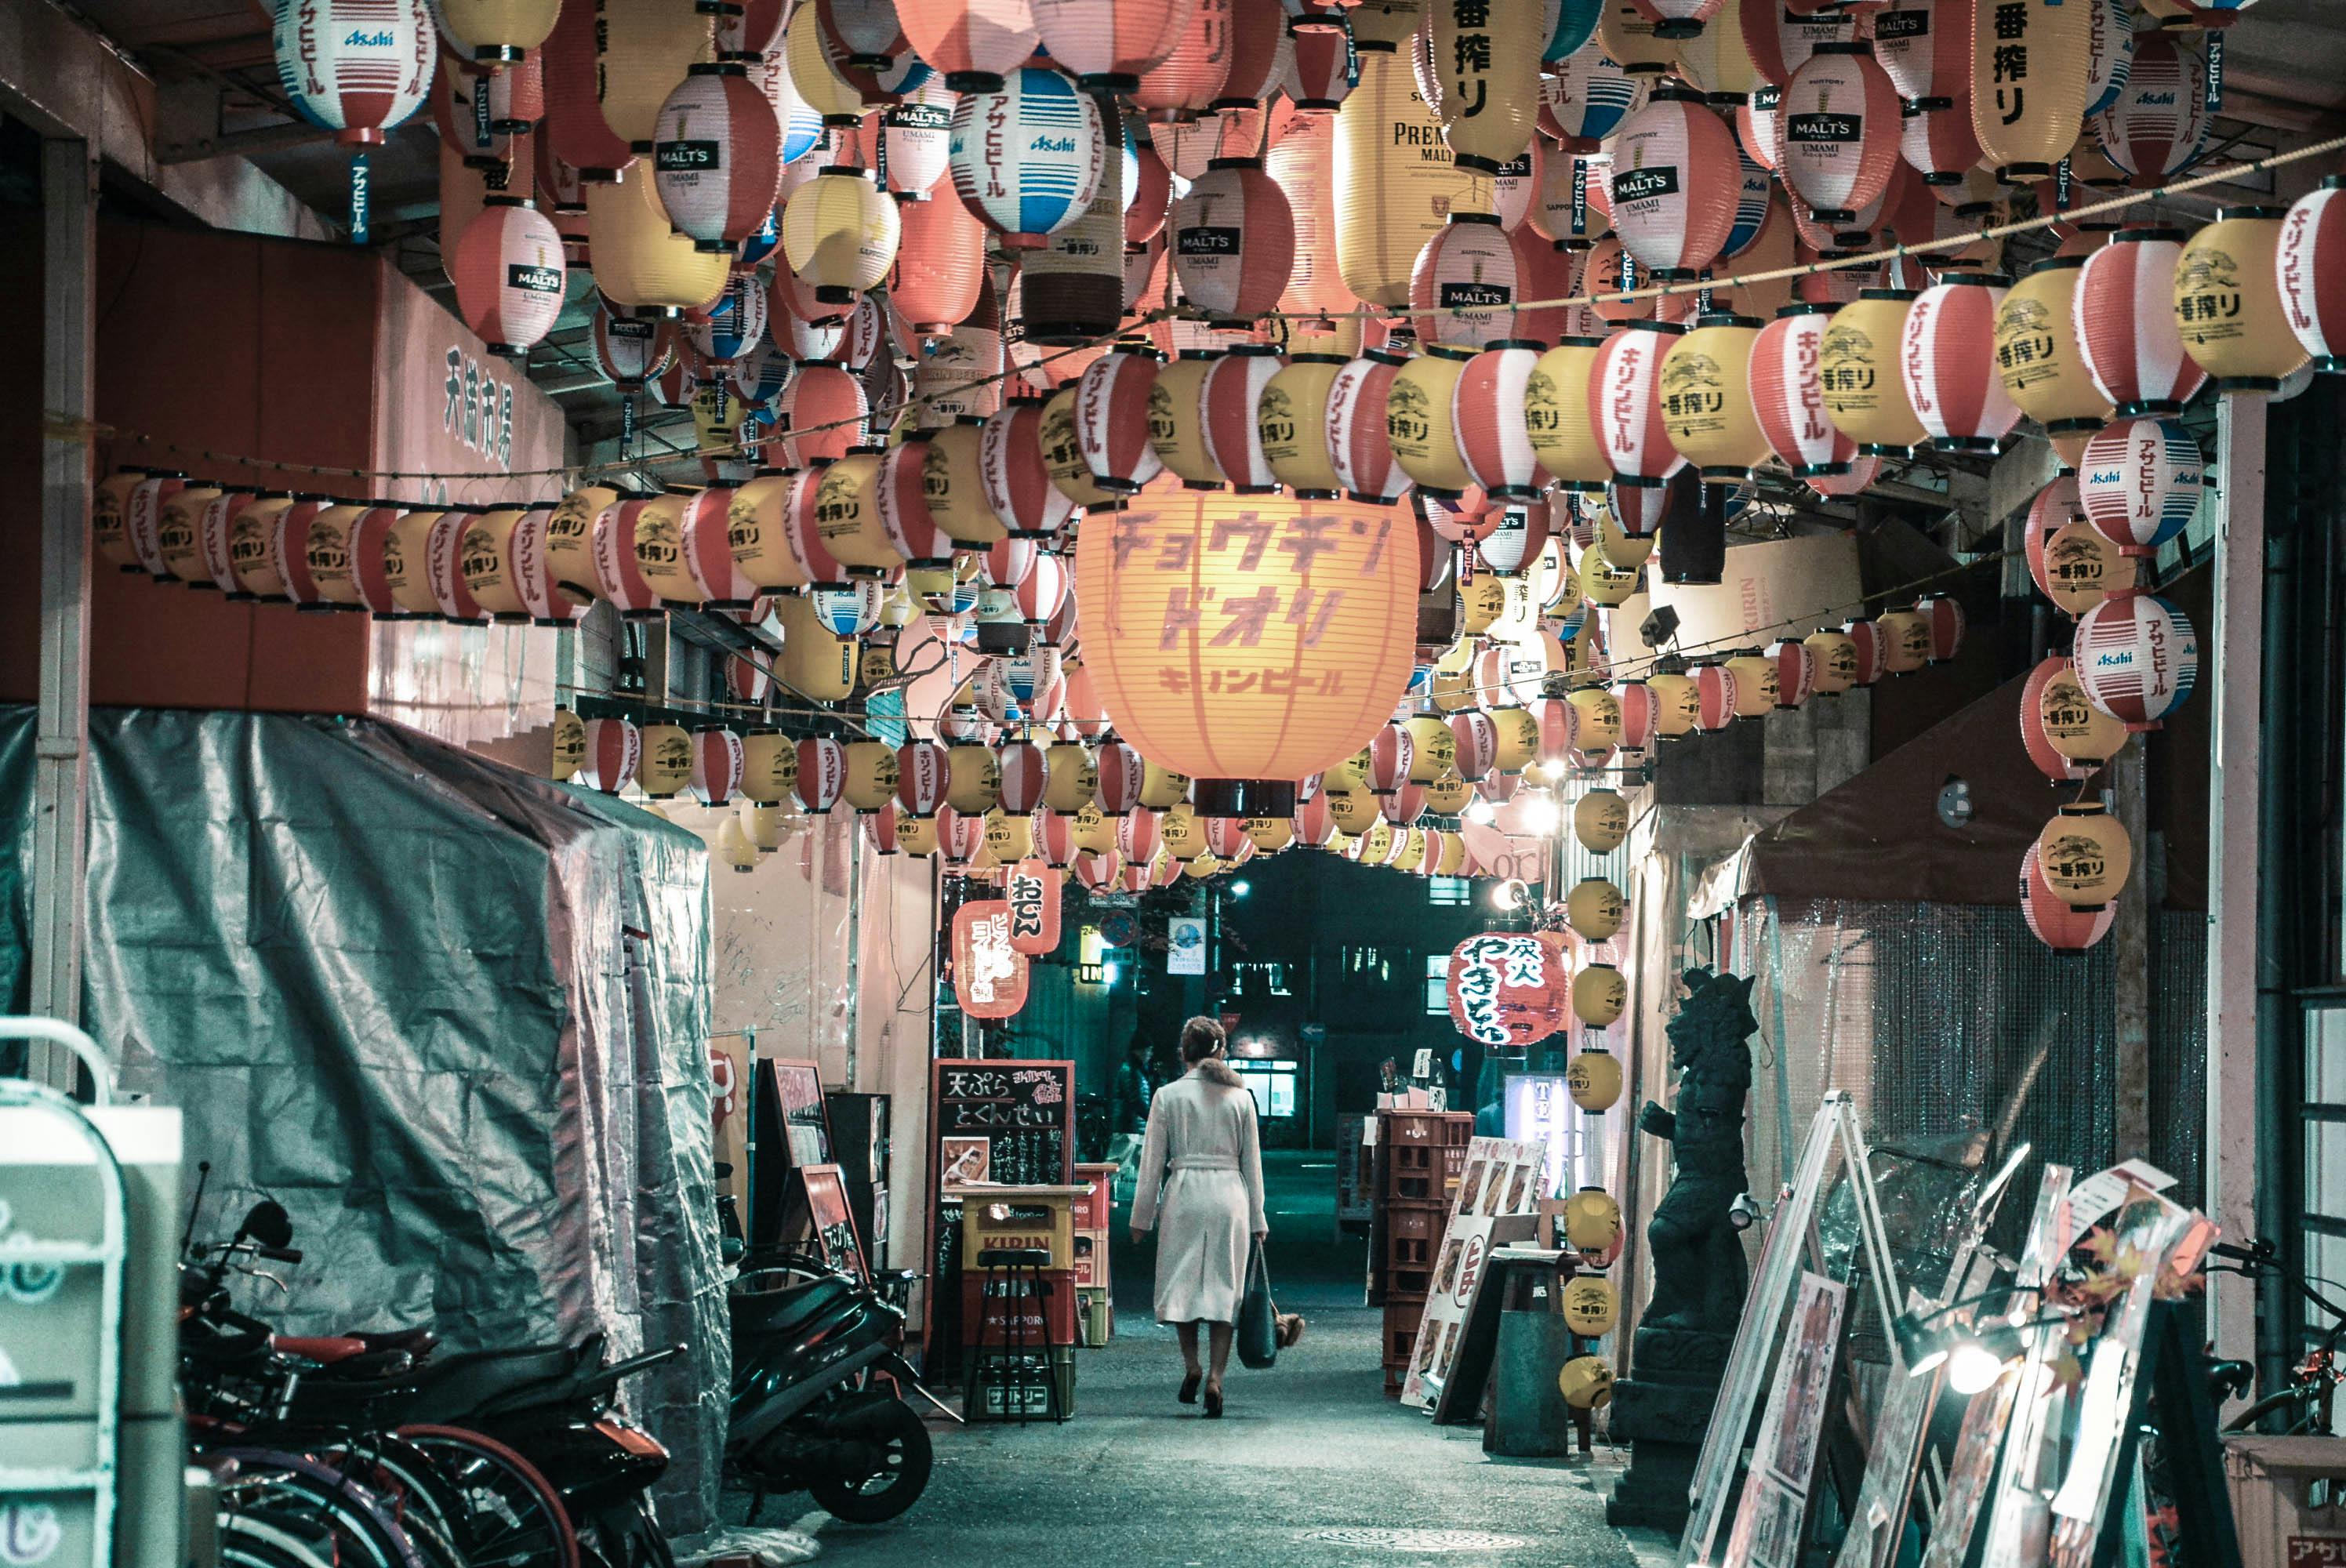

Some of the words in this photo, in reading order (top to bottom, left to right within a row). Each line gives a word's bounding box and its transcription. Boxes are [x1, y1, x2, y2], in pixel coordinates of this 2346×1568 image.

[345, 29, 394, 47] Asahi
[1803, 26, 1839, 35] UMAMI
[1994, 2, 2027, 126] 番搾り
[2208, 42, 2221, 103] アサヒビール
[2136, 91, 2176, 106] Asahi
[895, 111, 945, 125] MALT'S
[1796, 122, 1850, 135] MALT'S
[902, 130, 935, 140] UMAMI
[986, 95, 1009, 198] アサヒビール
[1030, 136, 1077, 153] Asahi
[1802, 144, 1839, 154] UMAMI
[660, 150, 707, 163] MALT'S
[666, 172, 699, 183] UMAMI
[1618, 175, 1666, 195] MALT'S
[352, 165, 367, 234] アサヒビール
[1574, 170, 1585, 227] アサヒビール
[1625, 198, 1660, 212] UMAMI
[1182, 235, 1229, 248] MALT'S
[1186, 256, 1219, 265] UMAMI
[2282, 209, 2312, 329] キリンビール
[518, 273, 559, 289] MALT'S
[1451, 292, 1502, 304] MALT'S
[2174, 293, 2241, 321] 番搾り
[1907, 302, 1932, 414] キリンビール
[1797, 331, 1826, 440] キリンビール
[932, 404, 966, 414] 一番搾り
[1084, 362, 1110, 454] キリンビール
[1614, 348, 1642, 453] キリンビール
[1330, 374, 1355, 471] キリンビール
[985, 421, 1005, 509] キリンビール
[2090, 471, 2120, 485] Asahi
[2136, 438, 2156, 518] アサヒビール
[2174, 471, 2199, 485] Asahi
[593, 513, 617, 594] キリンビール
[1112, 511, 1392, 576] チョウチン
[431, 522, 449, 601] キリンビール
[522, 521, 539, 601] キリンビール
[2050, 564, 2103, 579] 一番搾り
[1159, 586, 1346, 652] ドオリ
[865, 667, 892, 676] 一番搾り
[2097, 651, 2134, 666] Asahi
[2145, 619, 2168, 697] アサヒビール
[1158, 668, 1345, 696] キリンビール
[622, 727, 639, 781] キリンビール
[1398, 731, 1409, 781] キリンビール
[1476, 719, 1489, 768] キリンビール
[731, 738, 744, 791] キリンビール
[823, 746, 834, 798] キリンビール
[919, 750, 932, 802] キリンビール
[1125, 750, 1140, 801] キリンビール
[2048, 862, 2104, 877] 一番搾り
[1011, 876, 1043, 938] おでん
[1509, 939, 1540, 982] 炭火
[1462, 938, 1510, 1043] やきとり
[948, 1072, 1010, 1098] 天ぷら
[956, 1103, 1053, 1126] とくんせい
[983, 1237, 1049, 1249] KIRIN
[1000, 1316, 1044, 1325] SPPOR
[1571, 1305, 1608, 1316] 一番搾り
